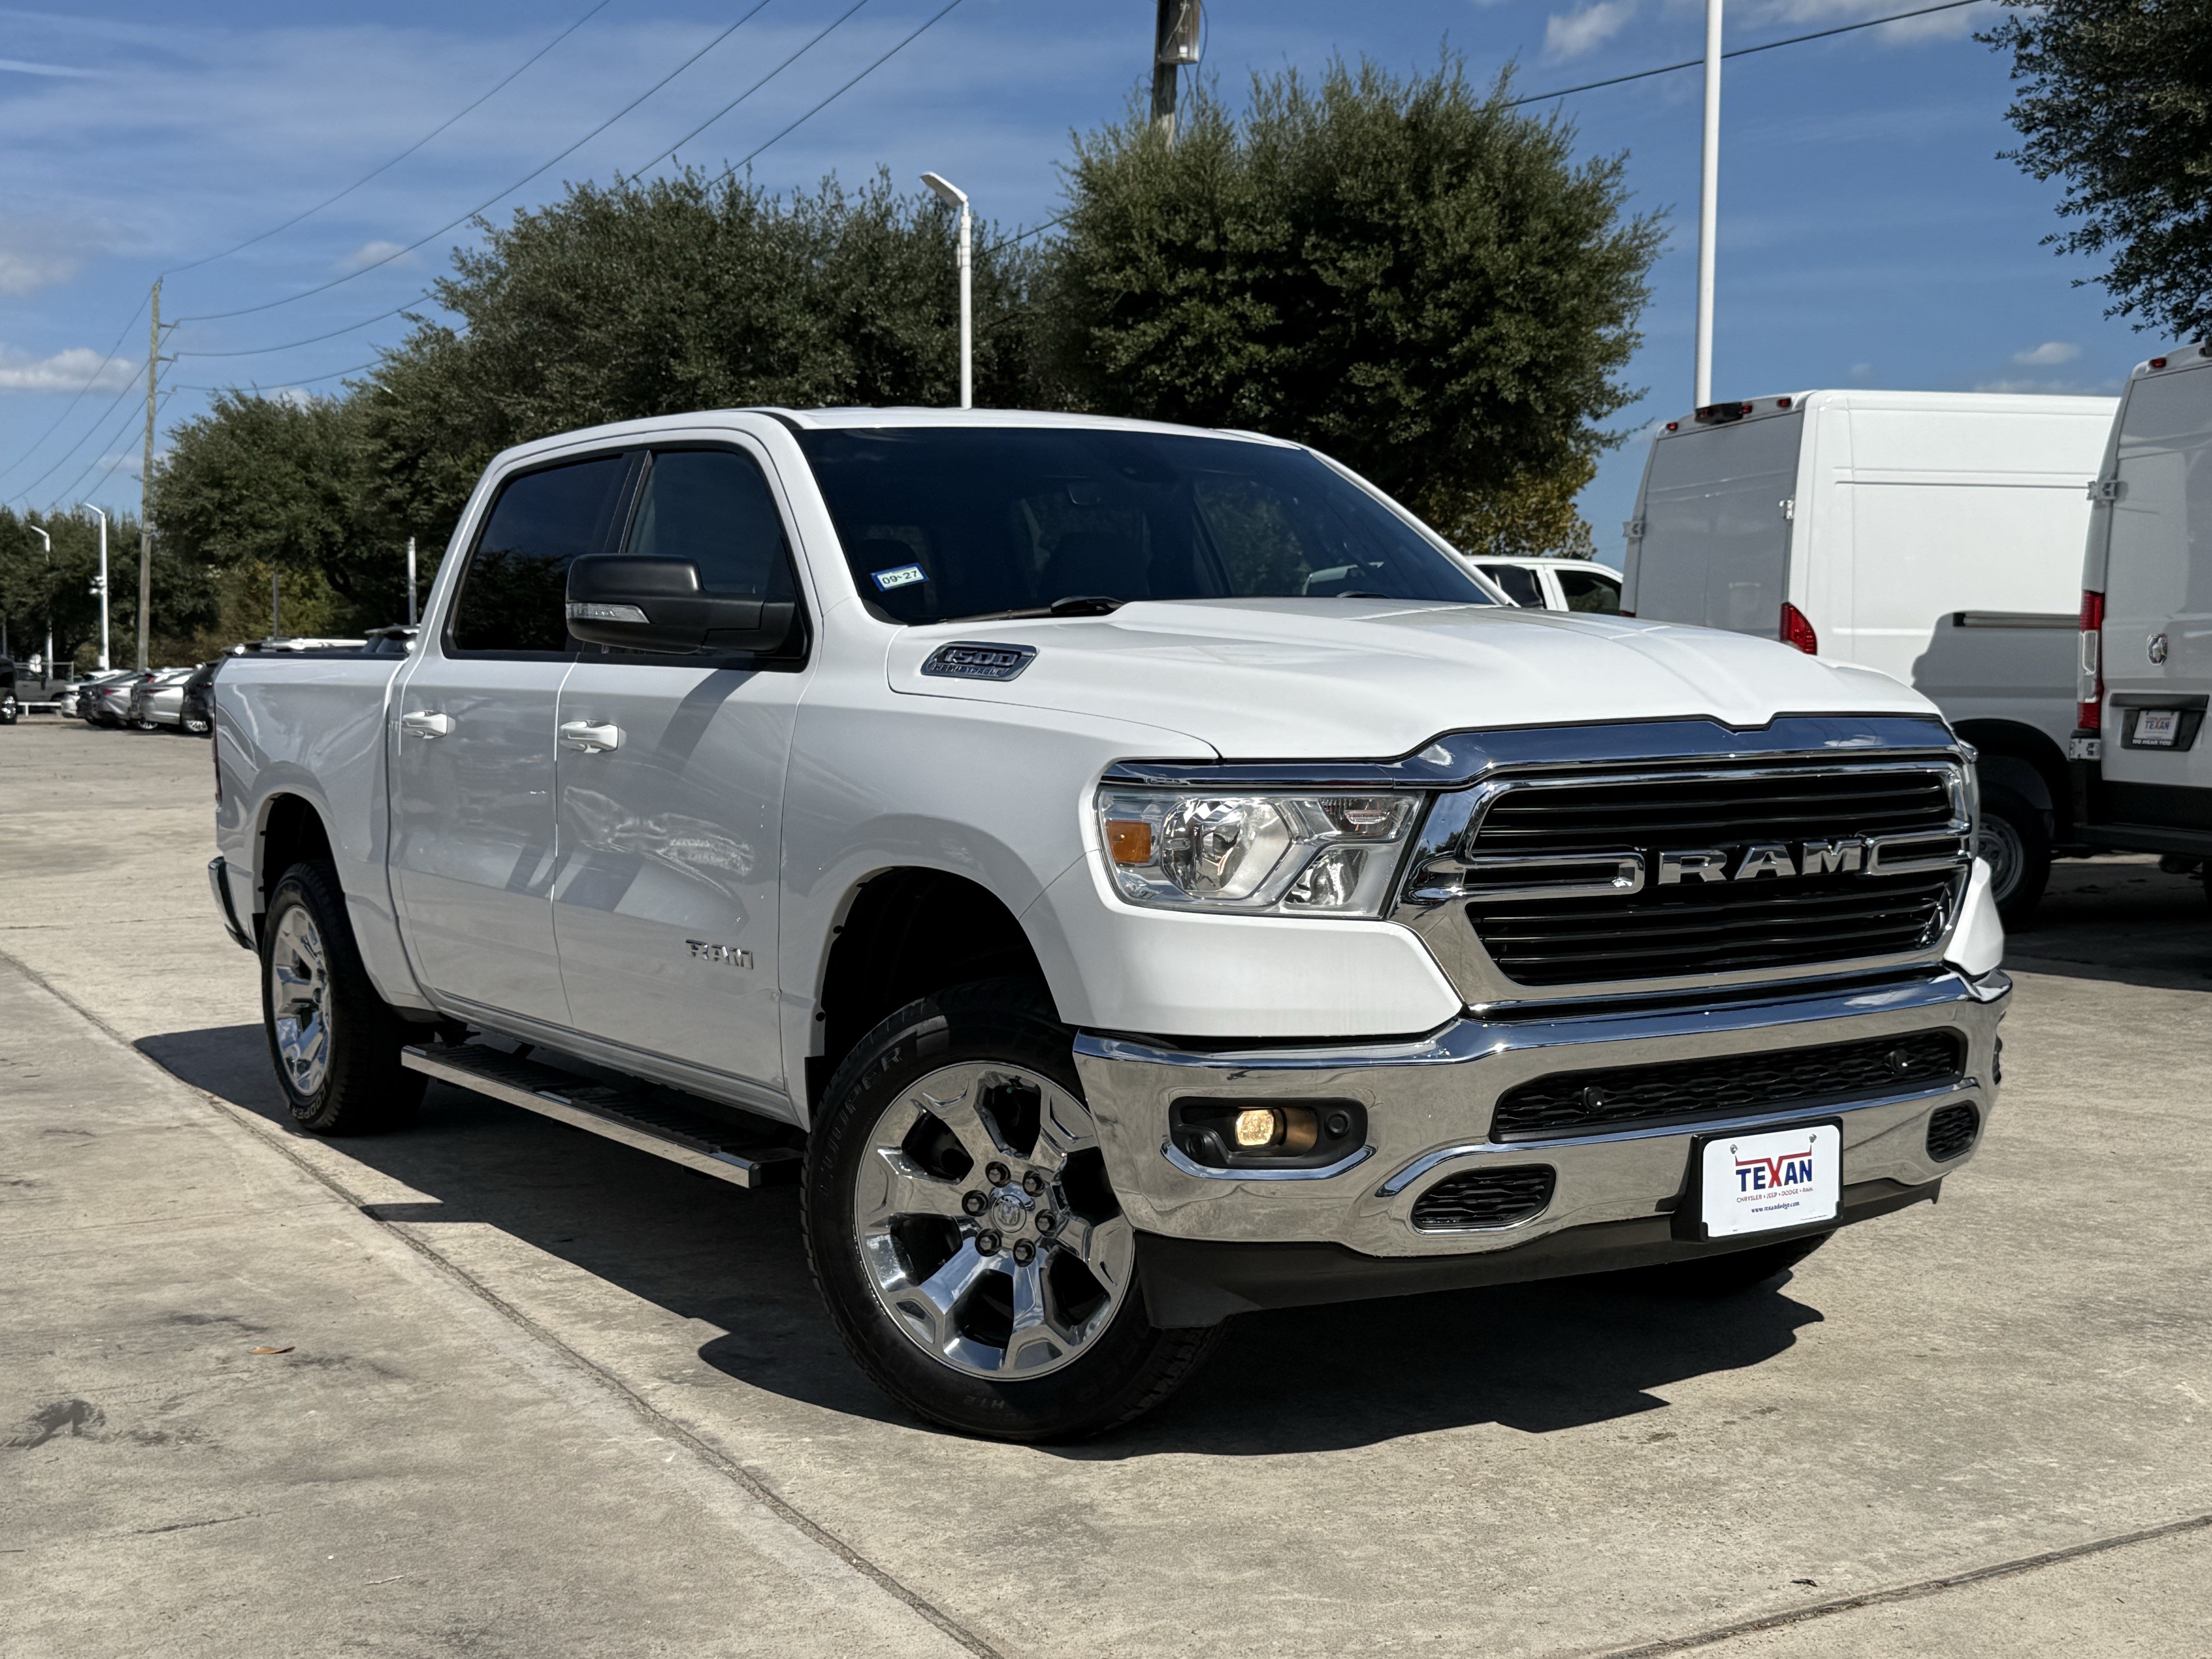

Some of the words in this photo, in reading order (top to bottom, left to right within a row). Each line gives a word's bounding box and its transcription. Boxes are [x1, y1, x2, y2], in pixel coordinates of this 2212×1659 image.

[882, 570, 917, 584] 09-27
[945, 649, 1018, 666] 1500
[2145, 718, 2170, 730] TEXAN
[1658, 838, 1861, 886] RAM
[1736, 1157, 1813, 1192] TEXAN
